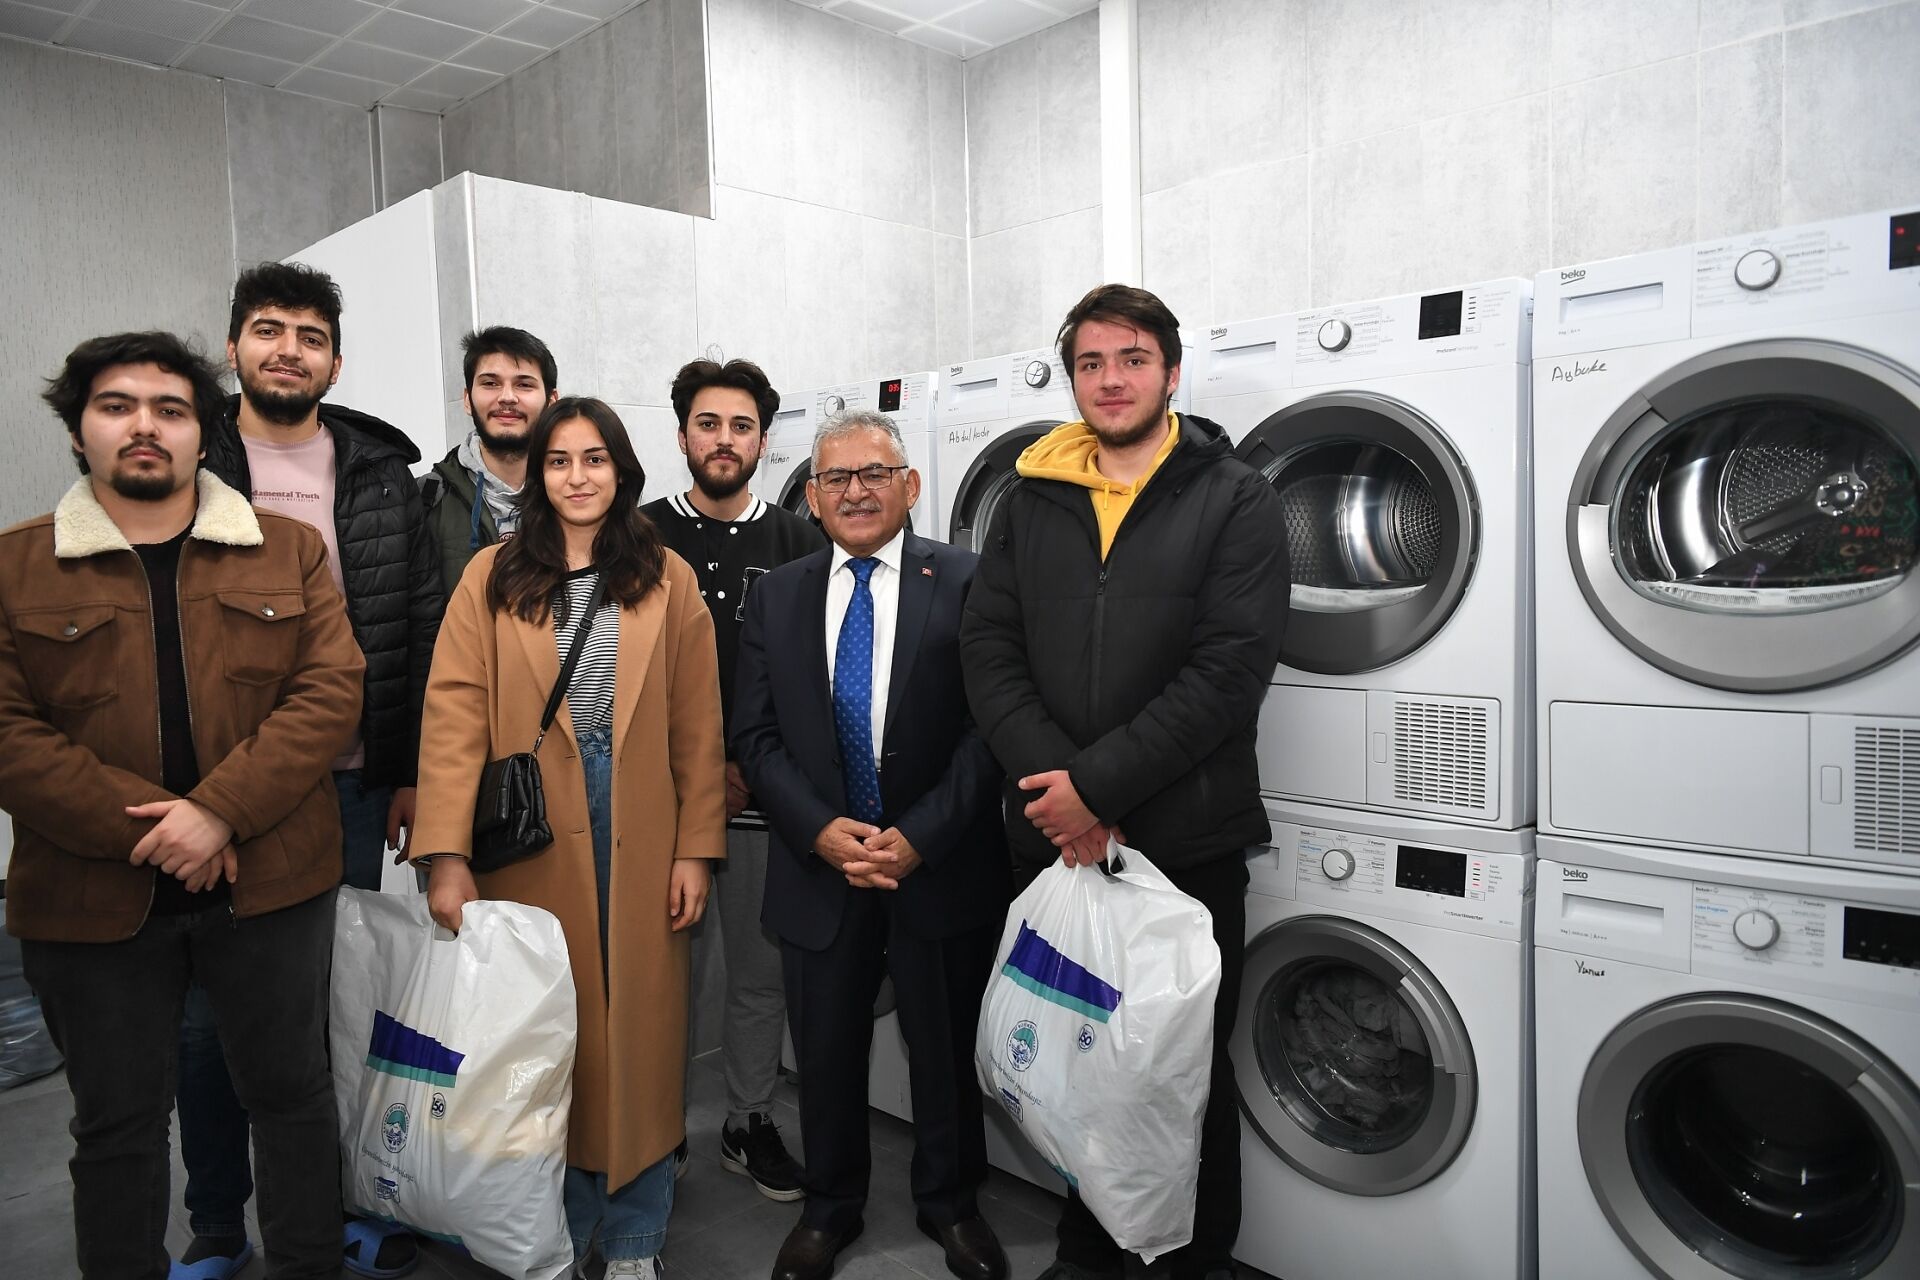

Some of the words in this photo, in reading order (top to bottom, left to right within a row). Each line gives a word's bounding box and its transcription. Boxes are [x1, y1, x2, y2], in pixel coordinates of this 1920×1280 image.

[1560, 269, 1586, 280] beko
[1210, 327, 1228, 337] beko
[295, 491, 320, 500] Truth
[1563, 868, 1588, 879] beko
